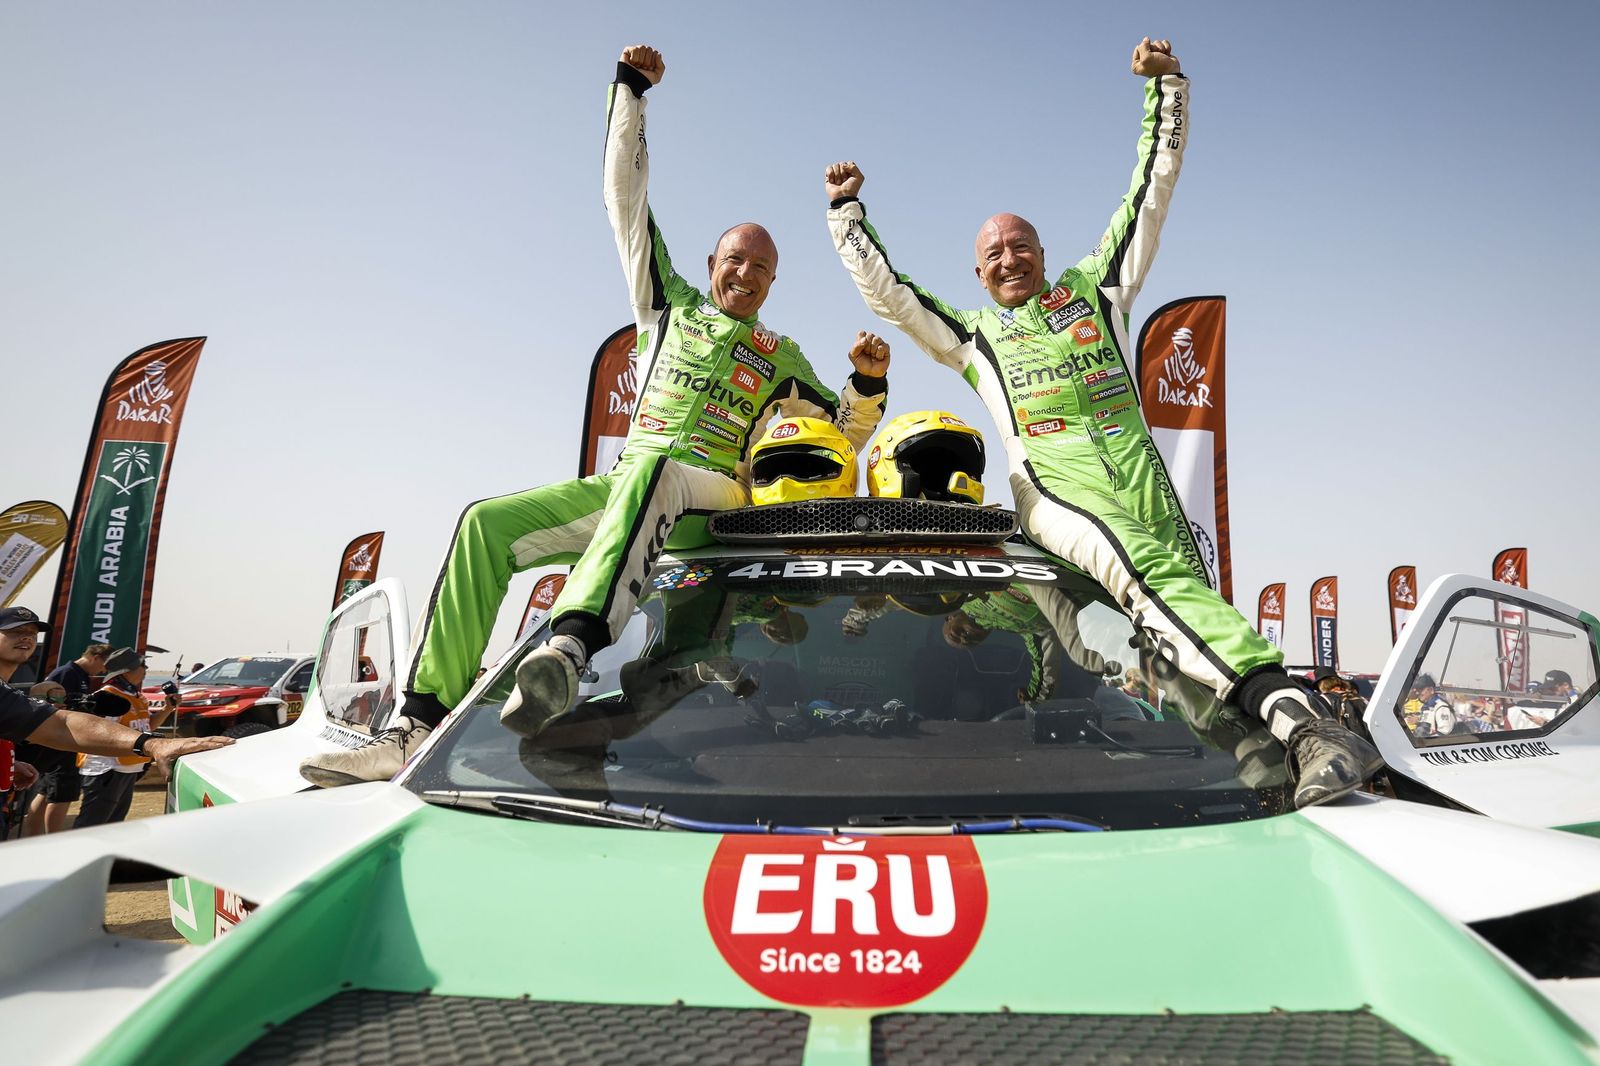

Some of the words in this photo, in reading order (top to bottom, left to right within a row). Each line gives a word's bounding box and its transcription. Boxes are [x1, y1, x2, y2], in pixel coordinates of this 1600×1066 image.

[1167, 91, 1182, 150] Emotive
[847, 218, 868, 259] Eotive
[1052, 308, 1091, 331] WORKWEAR
[1076, 326, 1097, 339] JBL
[734, 351, 771, 377] WORKWEAR
[1008, 346, 1116, 389] Emotive
[654, 360, 754, 416] Emotive
[738, 371, 755, 390] JBL
[1158, 377, 1213, 408] DAKAR
[116, 399, 173, 425] DAKAR
[774, 426, 798, 439] ERU
[1029, 420, 1061, 435] FEBO
[98, 505, 130, 587] ARABIA
[349, 561, 371, 572] DAKAR
[91, 593, 116, 644] AUDI
[1321, 620, 1332, 667] ENDER
[1419, 752, 1458, 766] TIM
[1450, 750, 1471, 764] &
[1460, 746, 1500, 763] TOM
[1495, 740, 1561, 760] CORONEL
[730, 852, 957, 938] ERU
[759, 948, 841, 974] Since
[850, 949, 923, 974] 1824
